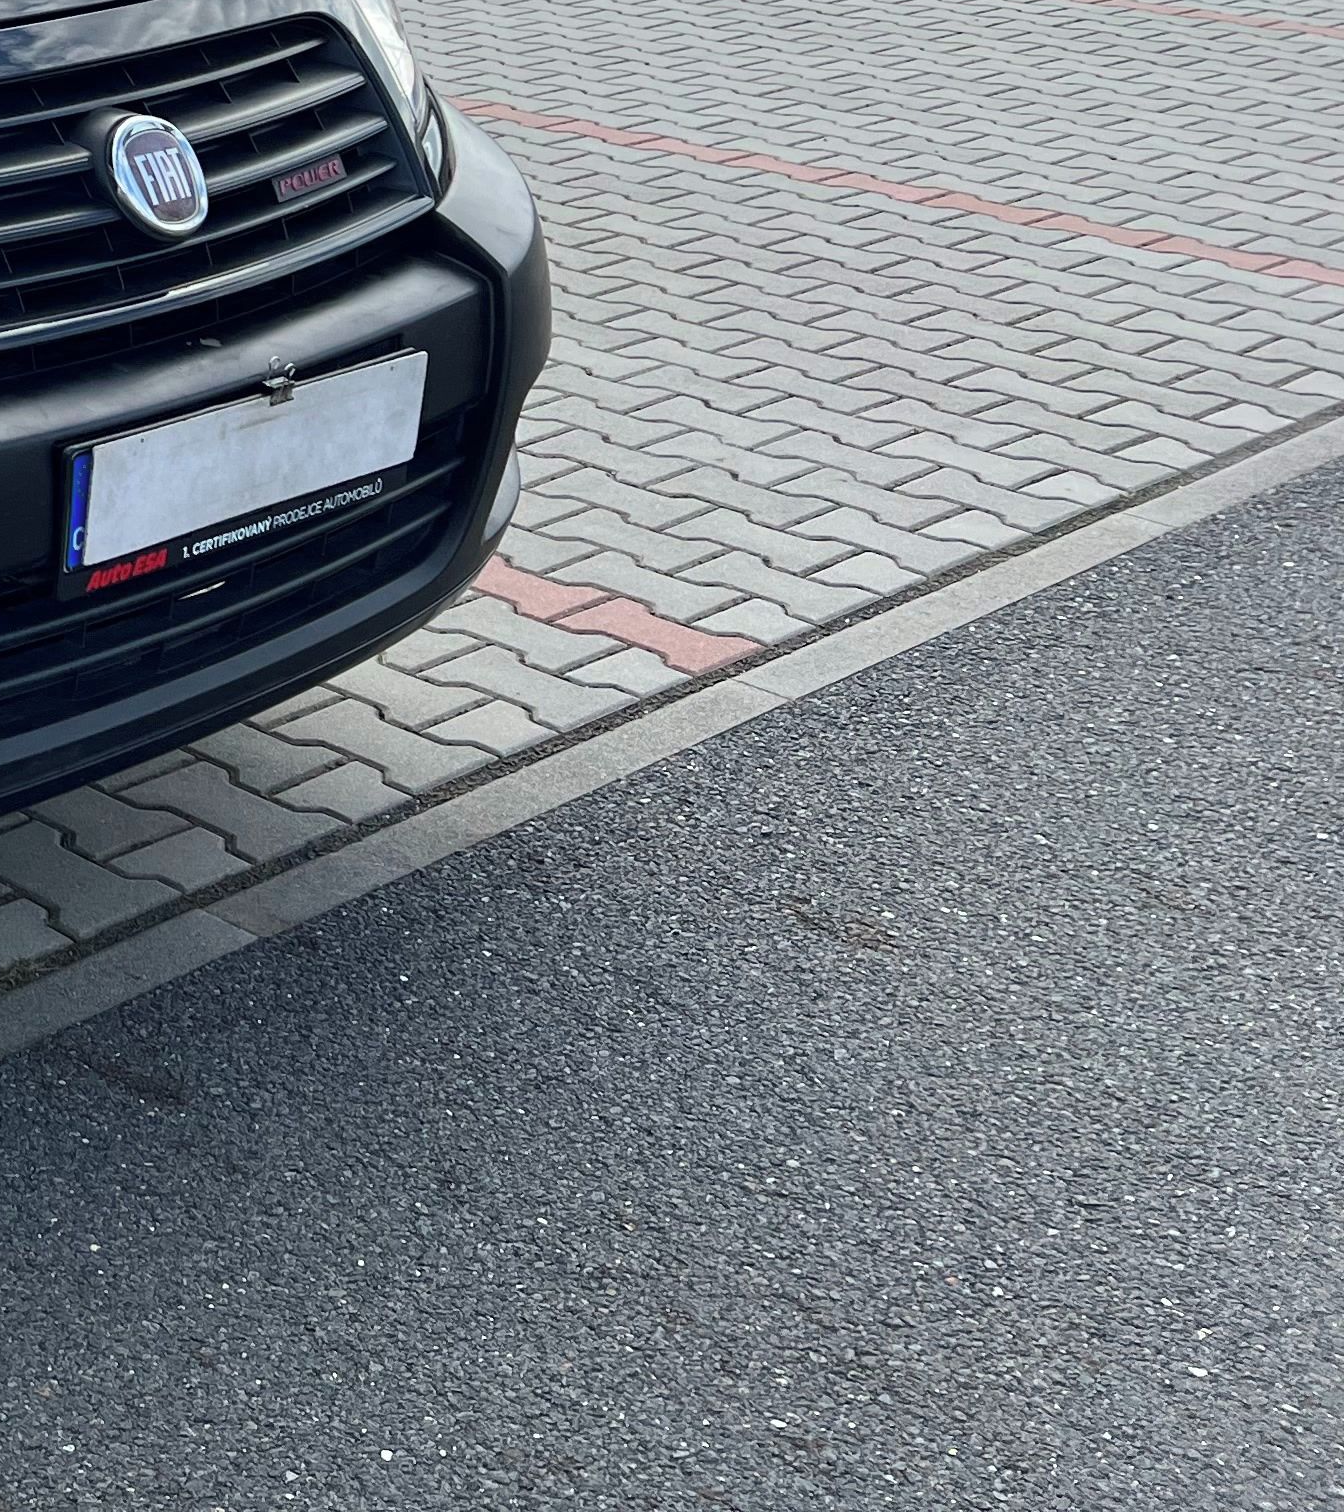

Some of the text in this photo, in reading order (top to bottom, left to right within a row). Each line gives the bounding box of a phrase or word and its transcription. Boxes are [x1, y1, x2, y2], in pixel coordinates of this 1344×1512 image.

[133, 147, 192, 207] FIAT
[279, 159, 341, 197] POWER
[182, 477, 384, 558] 1. CERTIFIKOVANÝ PRODEJCE AUTOMOBILŮ
[132, 548, 168, 577] ESA
